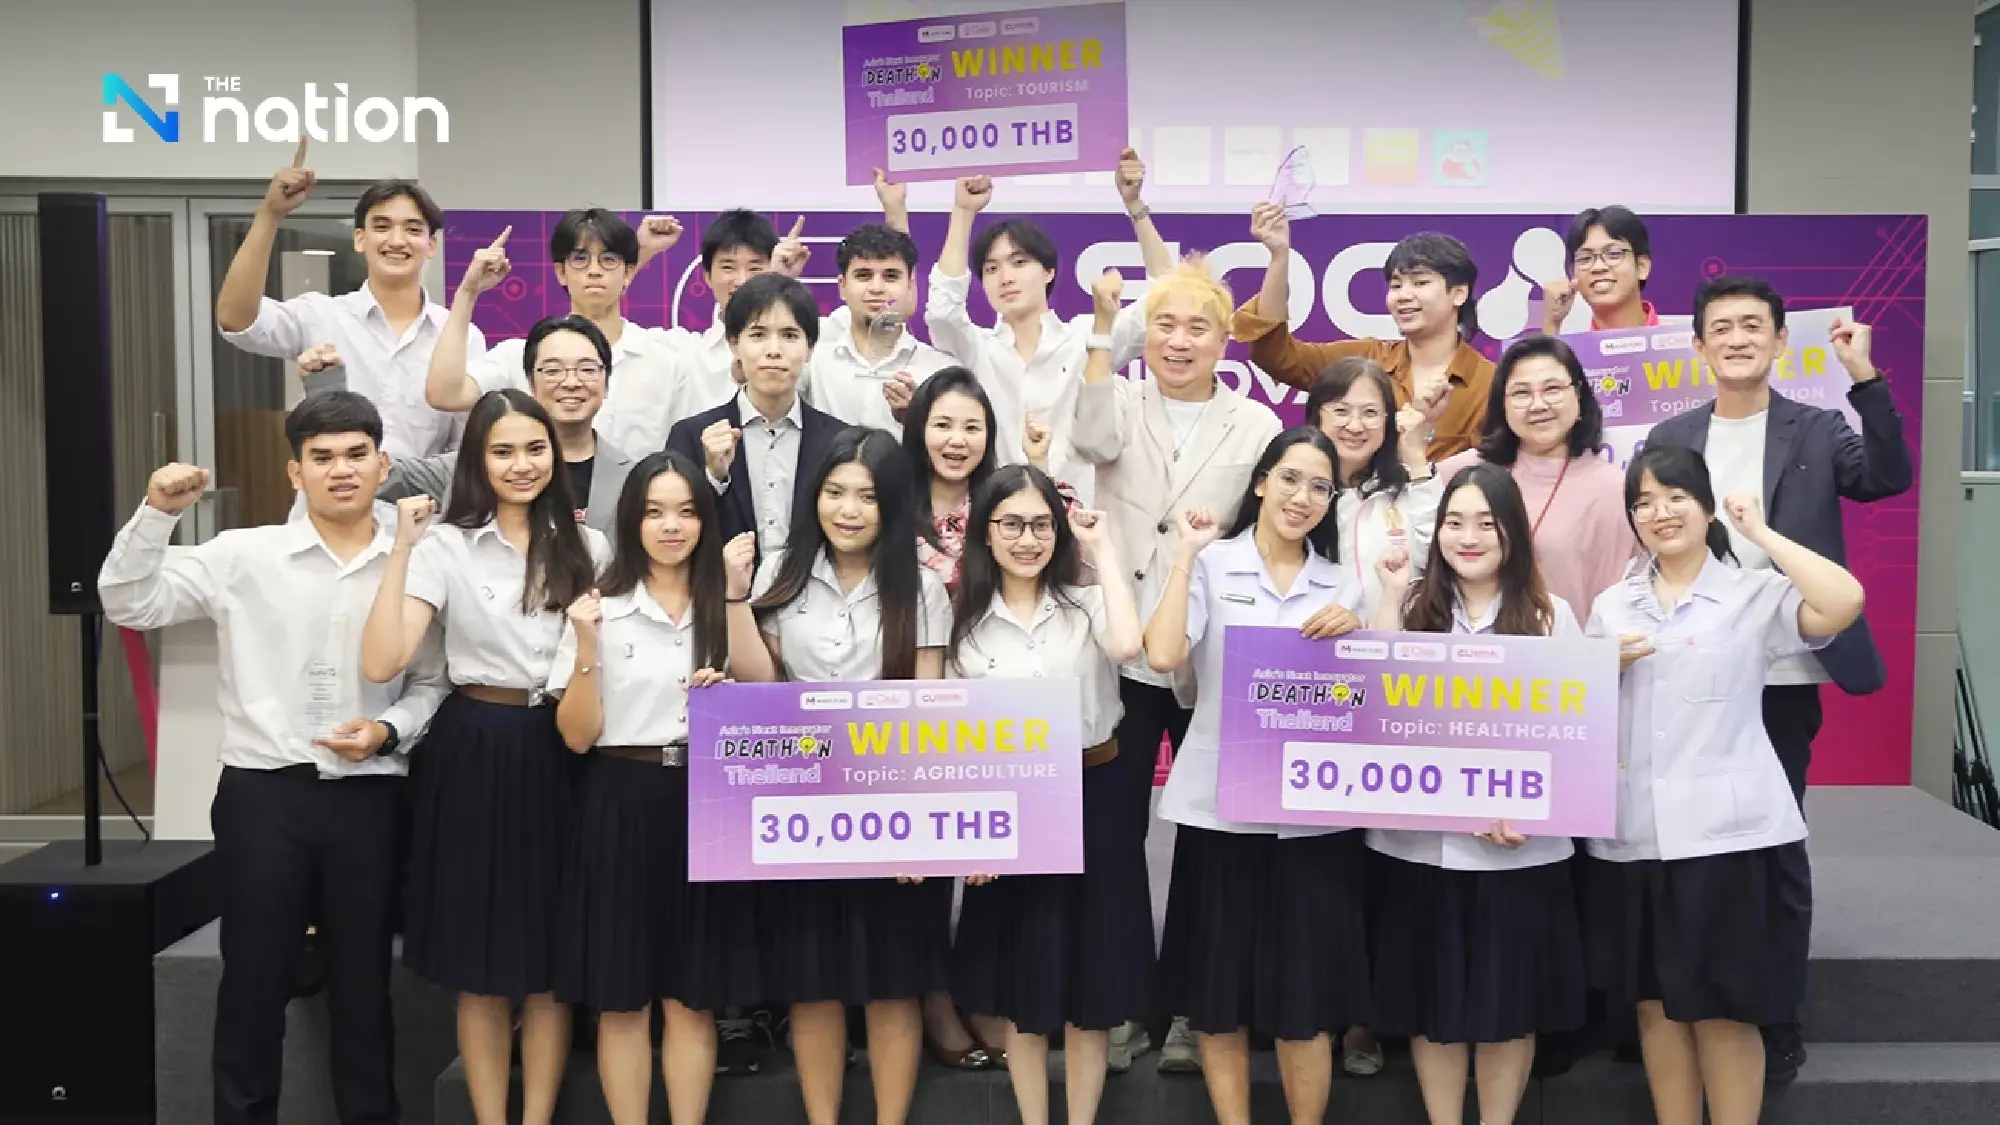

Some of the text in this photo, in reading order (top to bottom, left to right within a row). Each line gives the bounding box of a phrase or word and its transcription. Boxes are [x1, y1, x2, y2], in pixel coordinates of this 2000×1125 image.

[952, 39, 1103, 78] WINNER
[966, 79, 1089, 102] Topic: TOURISM
[892, 119, 1073, 155] 30,000 THB
[1642, 346, 1827, 390] WIER
[1381, 672, 1588, 714] WINNER
[847, 719, 1051, 756] WINNER
[1379, 718, 1588, 741] Topic: HEALTHCARE
[842, 763, 1058, 785] Topic: AGRICULTURE
[1290, 759, 1543, 799] 30,000 THB
[760, 810, 1012, 847] 30,000 THB
